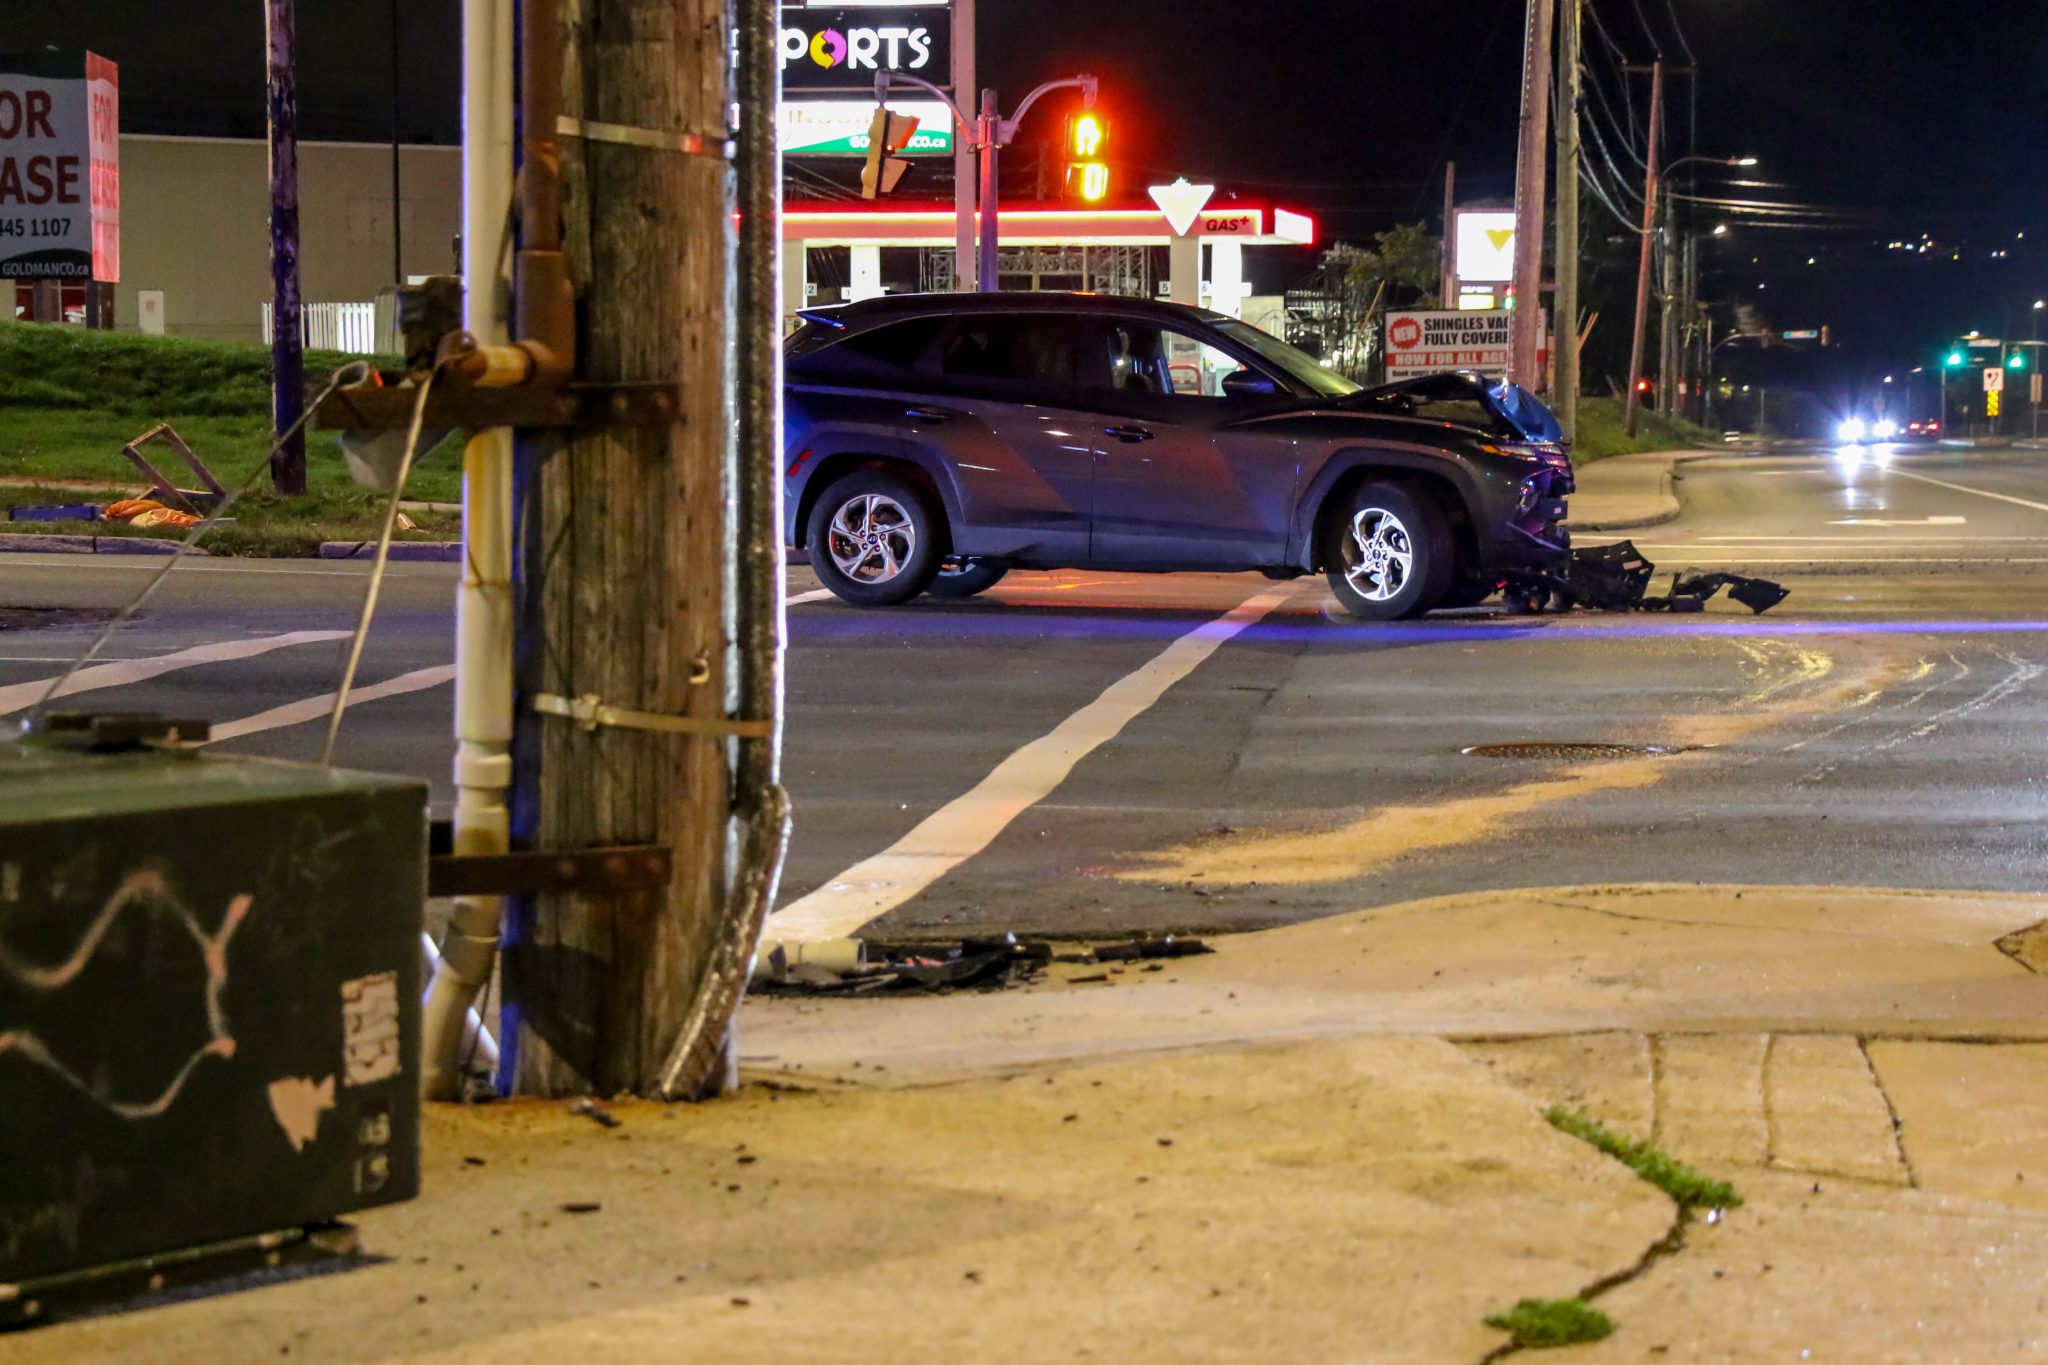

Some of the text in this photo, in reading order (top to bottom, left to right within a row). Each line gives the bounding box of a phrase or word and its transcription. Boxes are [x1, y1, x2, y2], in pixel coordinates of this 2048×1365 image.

[0, 89, 56, 139] OR
[0, 155, 80, 205] ASE
[0, 218, 71, 237] 45 1107
[2, 261, 89, 276] GOLDMANCO.ca
[808, 285, 814, 294] 2
[1162, 283, 1168, 292] 5
[1424, 317, 1484, 331] SHINGLES
[1424, 332, 1459, 346] FULLY
[1395, 352, 1427, 365] NOW
[1429, 351, 1453, 364] FOR
[1457, 351, 1479, 363] ALL
